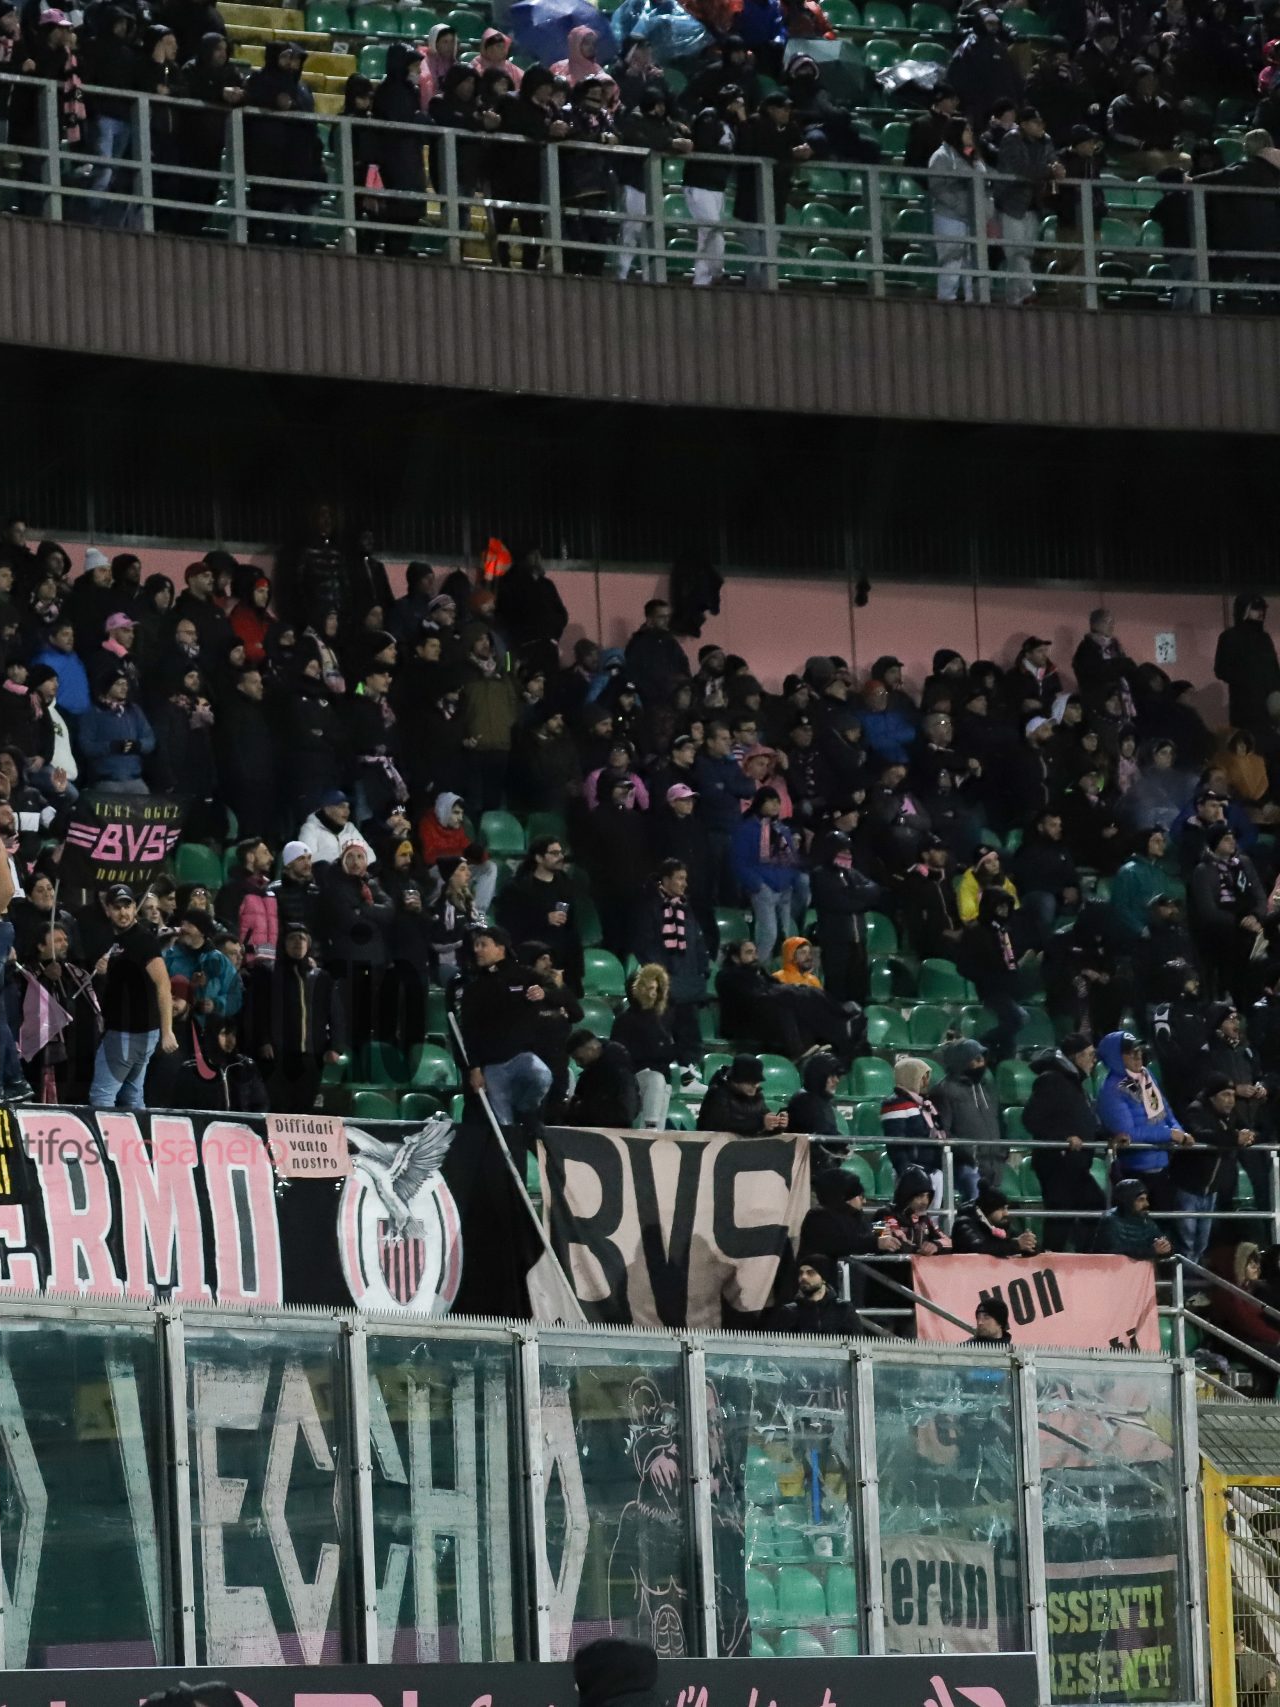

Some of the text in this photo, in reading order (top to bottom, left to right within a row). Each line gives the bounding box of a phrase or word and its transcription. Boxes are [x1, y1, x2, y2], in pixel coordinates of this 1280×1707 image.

[91, 824, 167, 862] BVS
[275, 1118, 334, 1135] Diffidati
[289, 1140, 328, 1153] vanto
[292, 1157, 338, 1169] nostro
